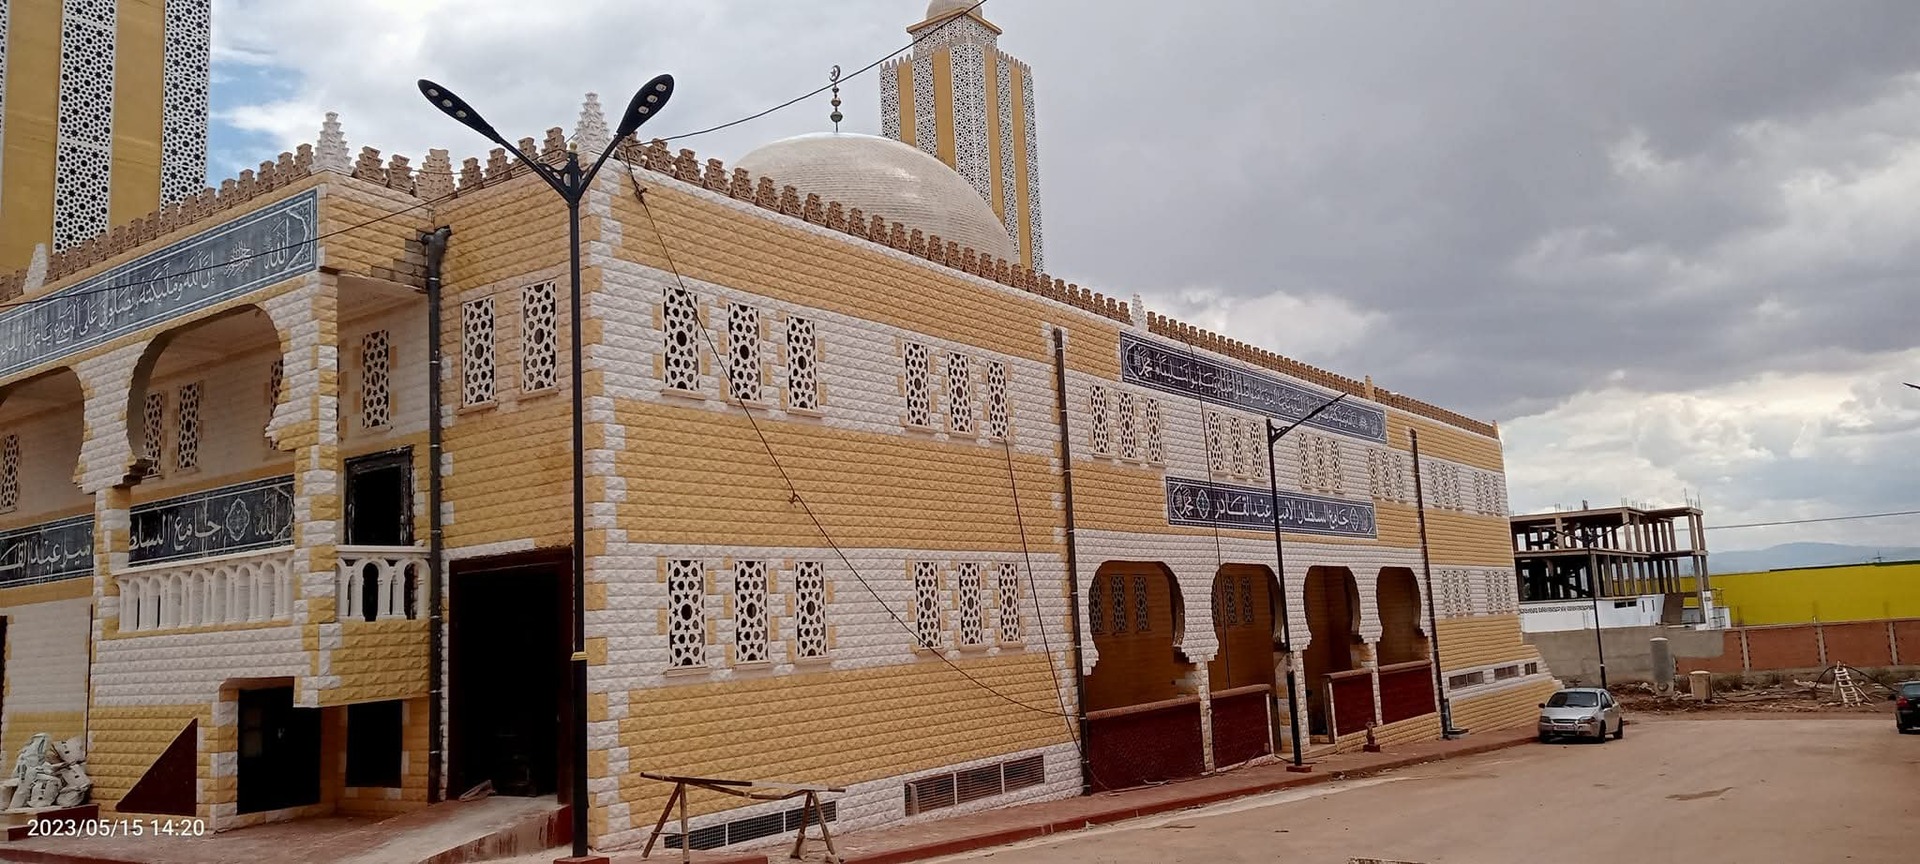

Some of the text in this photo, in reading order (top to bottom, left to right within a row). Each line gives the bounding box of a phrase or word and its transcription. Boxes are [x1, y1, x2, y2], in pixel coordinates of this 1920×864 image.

[1215, 492, 1252, 519] القادر
[1252, 500, 1271, 523] عبد
[1297, 501, 1329, 525] السلطان
[1329, 505, 1349, 530] جامع
[174, 508, 222, 551] جامع
